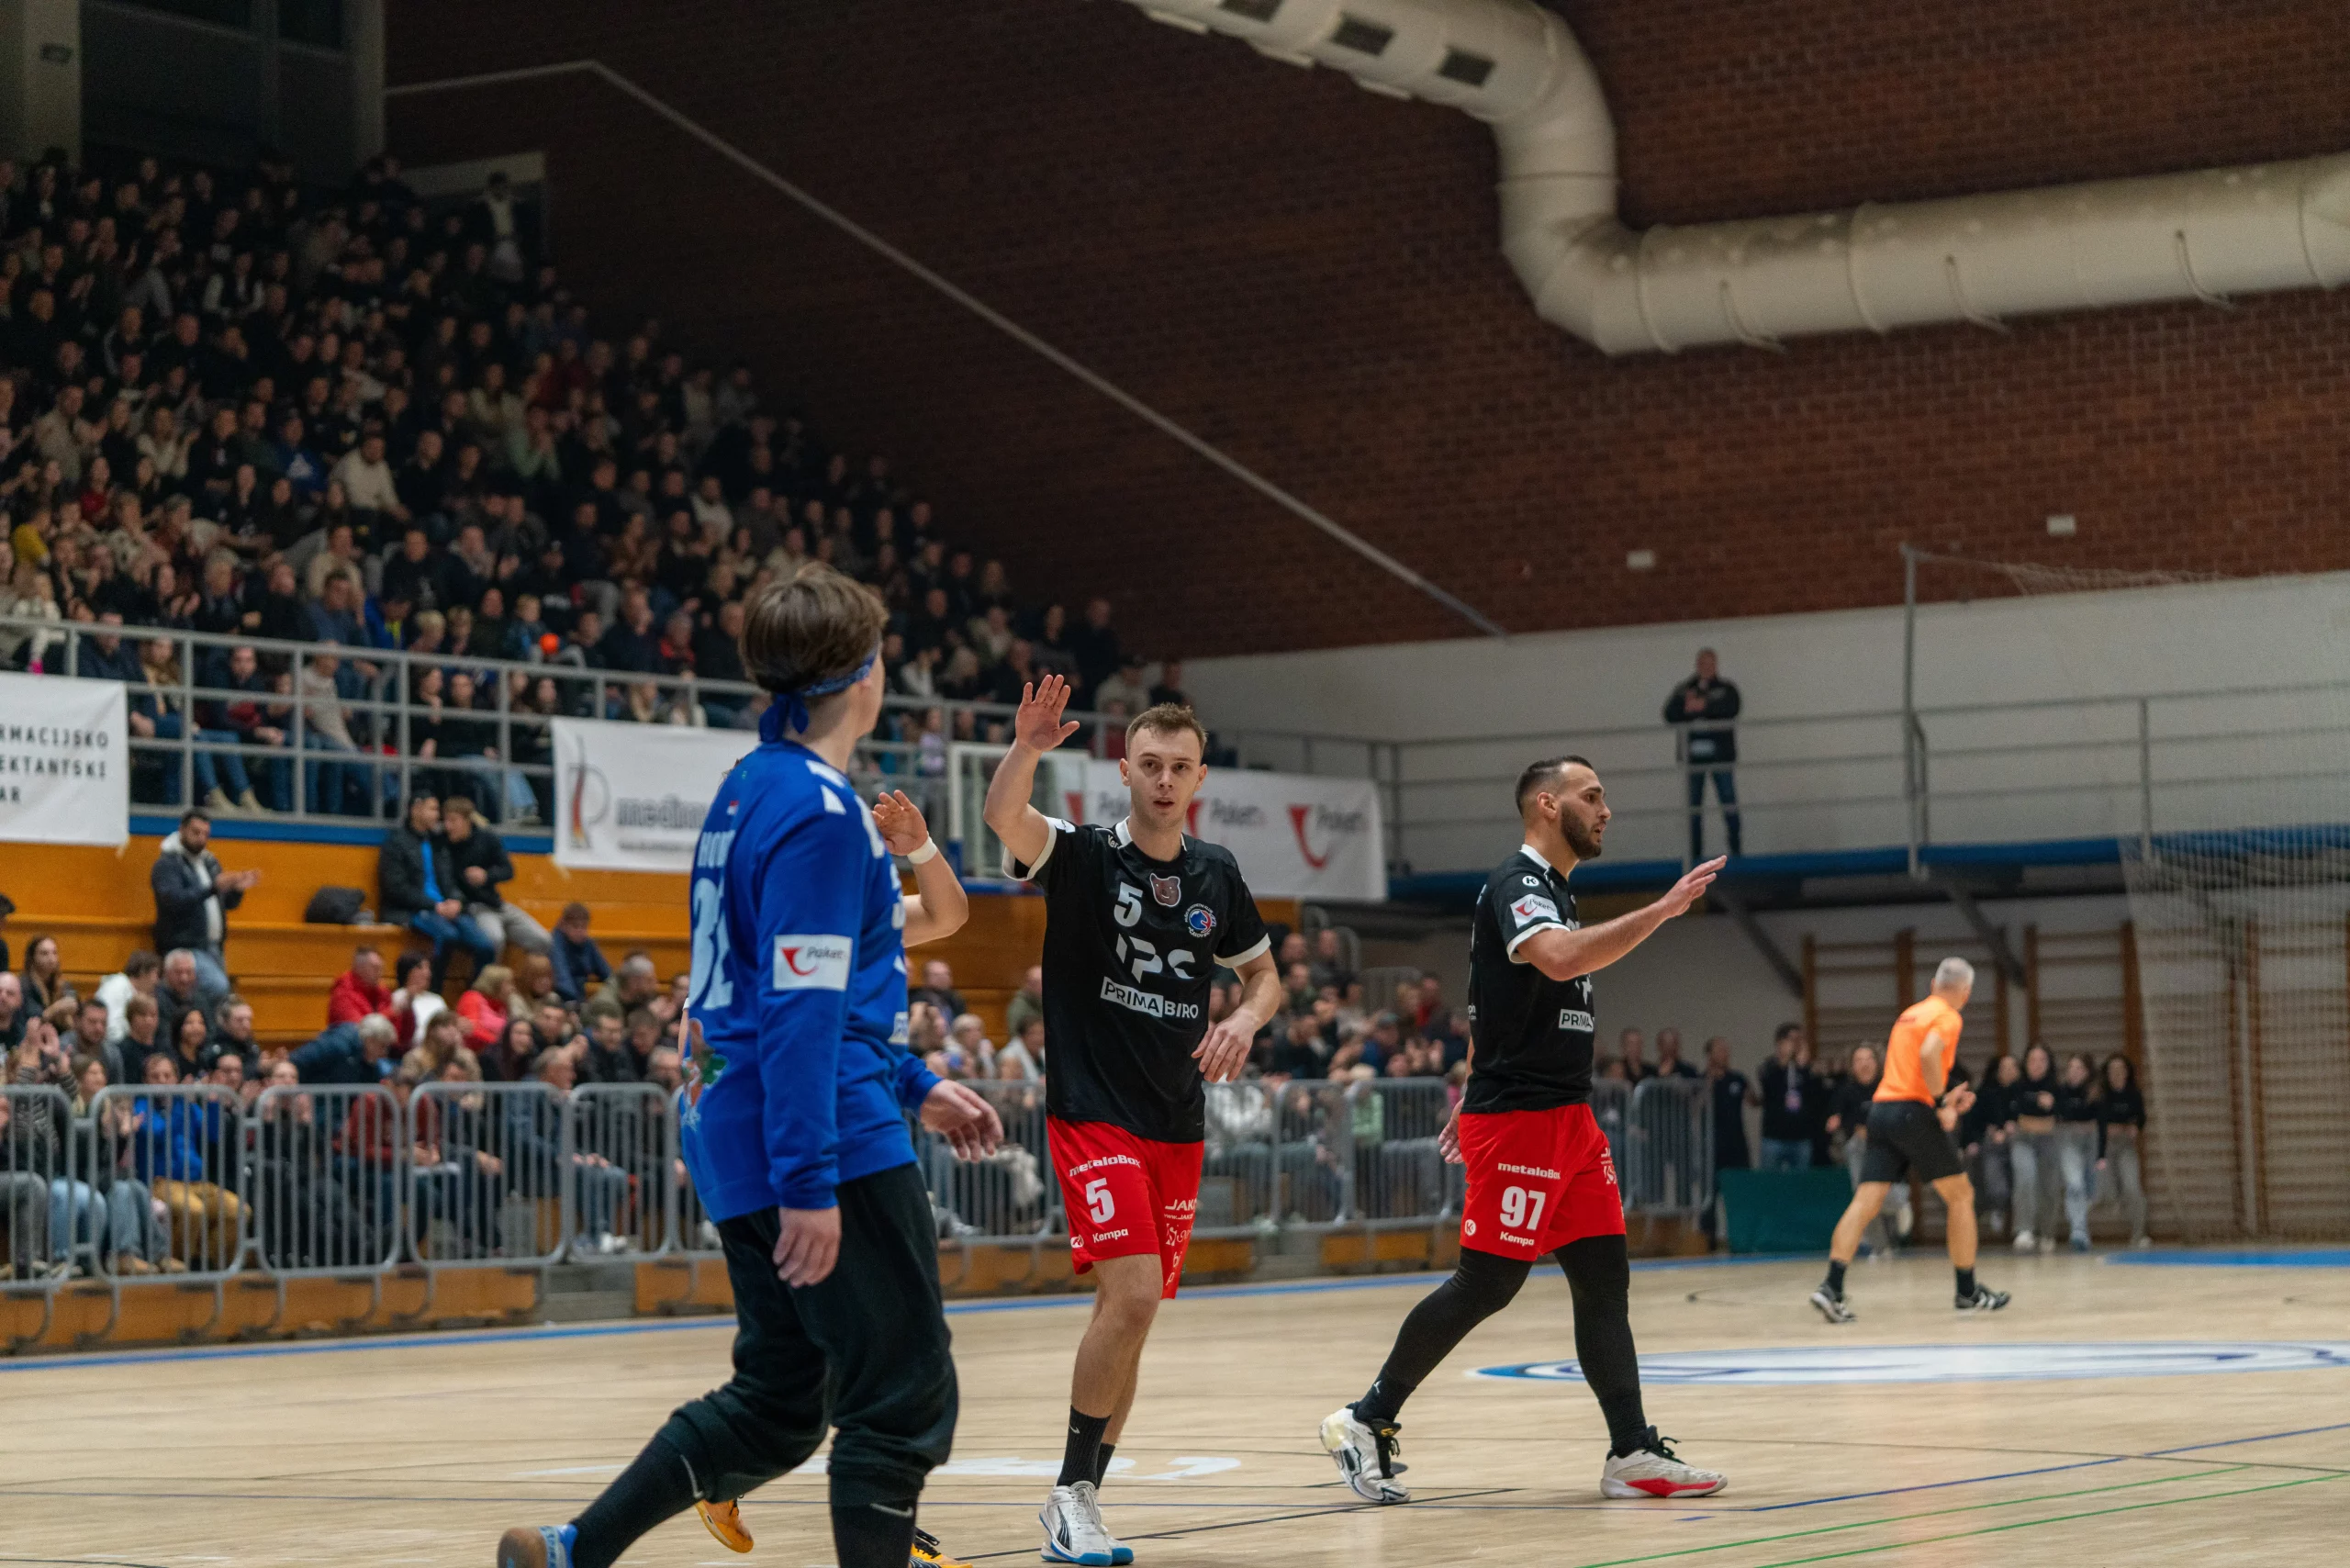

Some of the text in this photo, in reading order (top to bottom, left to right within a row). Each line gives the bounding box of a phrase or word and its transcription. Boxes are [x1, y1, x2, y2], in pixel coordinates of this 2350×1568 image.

[1113, 881, 1144, 927] 5
[1069, 1155, 1141, 1177] metaloBox
[1085, 1177, 1115, 1224] 5
[1499, 1185, 1547, 1231] 97
[1092, 1227, 1129, 1244] Kempa
[1499, 1230, 1535, 1247] Kempa
